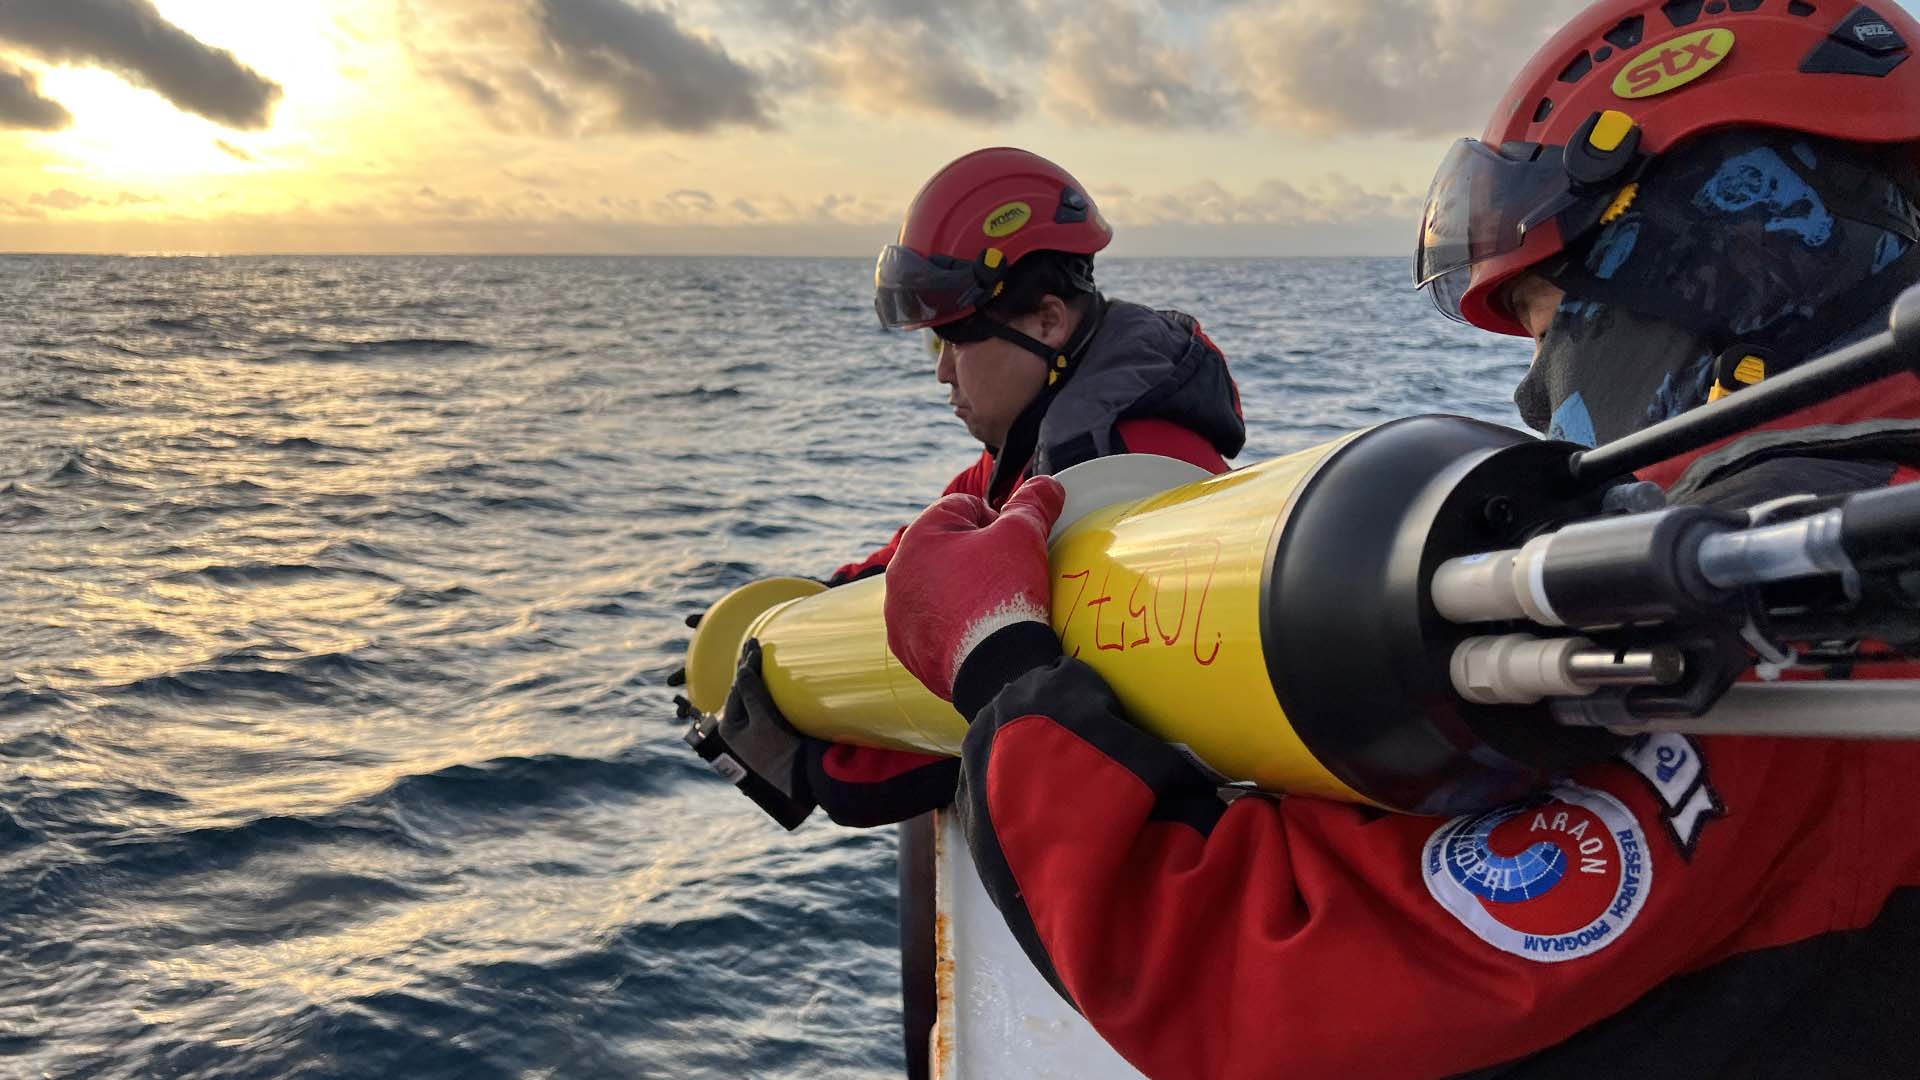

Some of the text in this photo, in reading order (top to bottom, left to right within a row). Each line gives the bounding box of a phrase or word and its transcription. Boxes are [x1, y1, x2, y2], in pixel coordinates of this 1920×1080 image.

[1060, 537, 1223, 666] 20572
[1524, 828, 1642, 953] RESEARCH PROGRAM
[1530, 811, 1608, 874] ARAON
